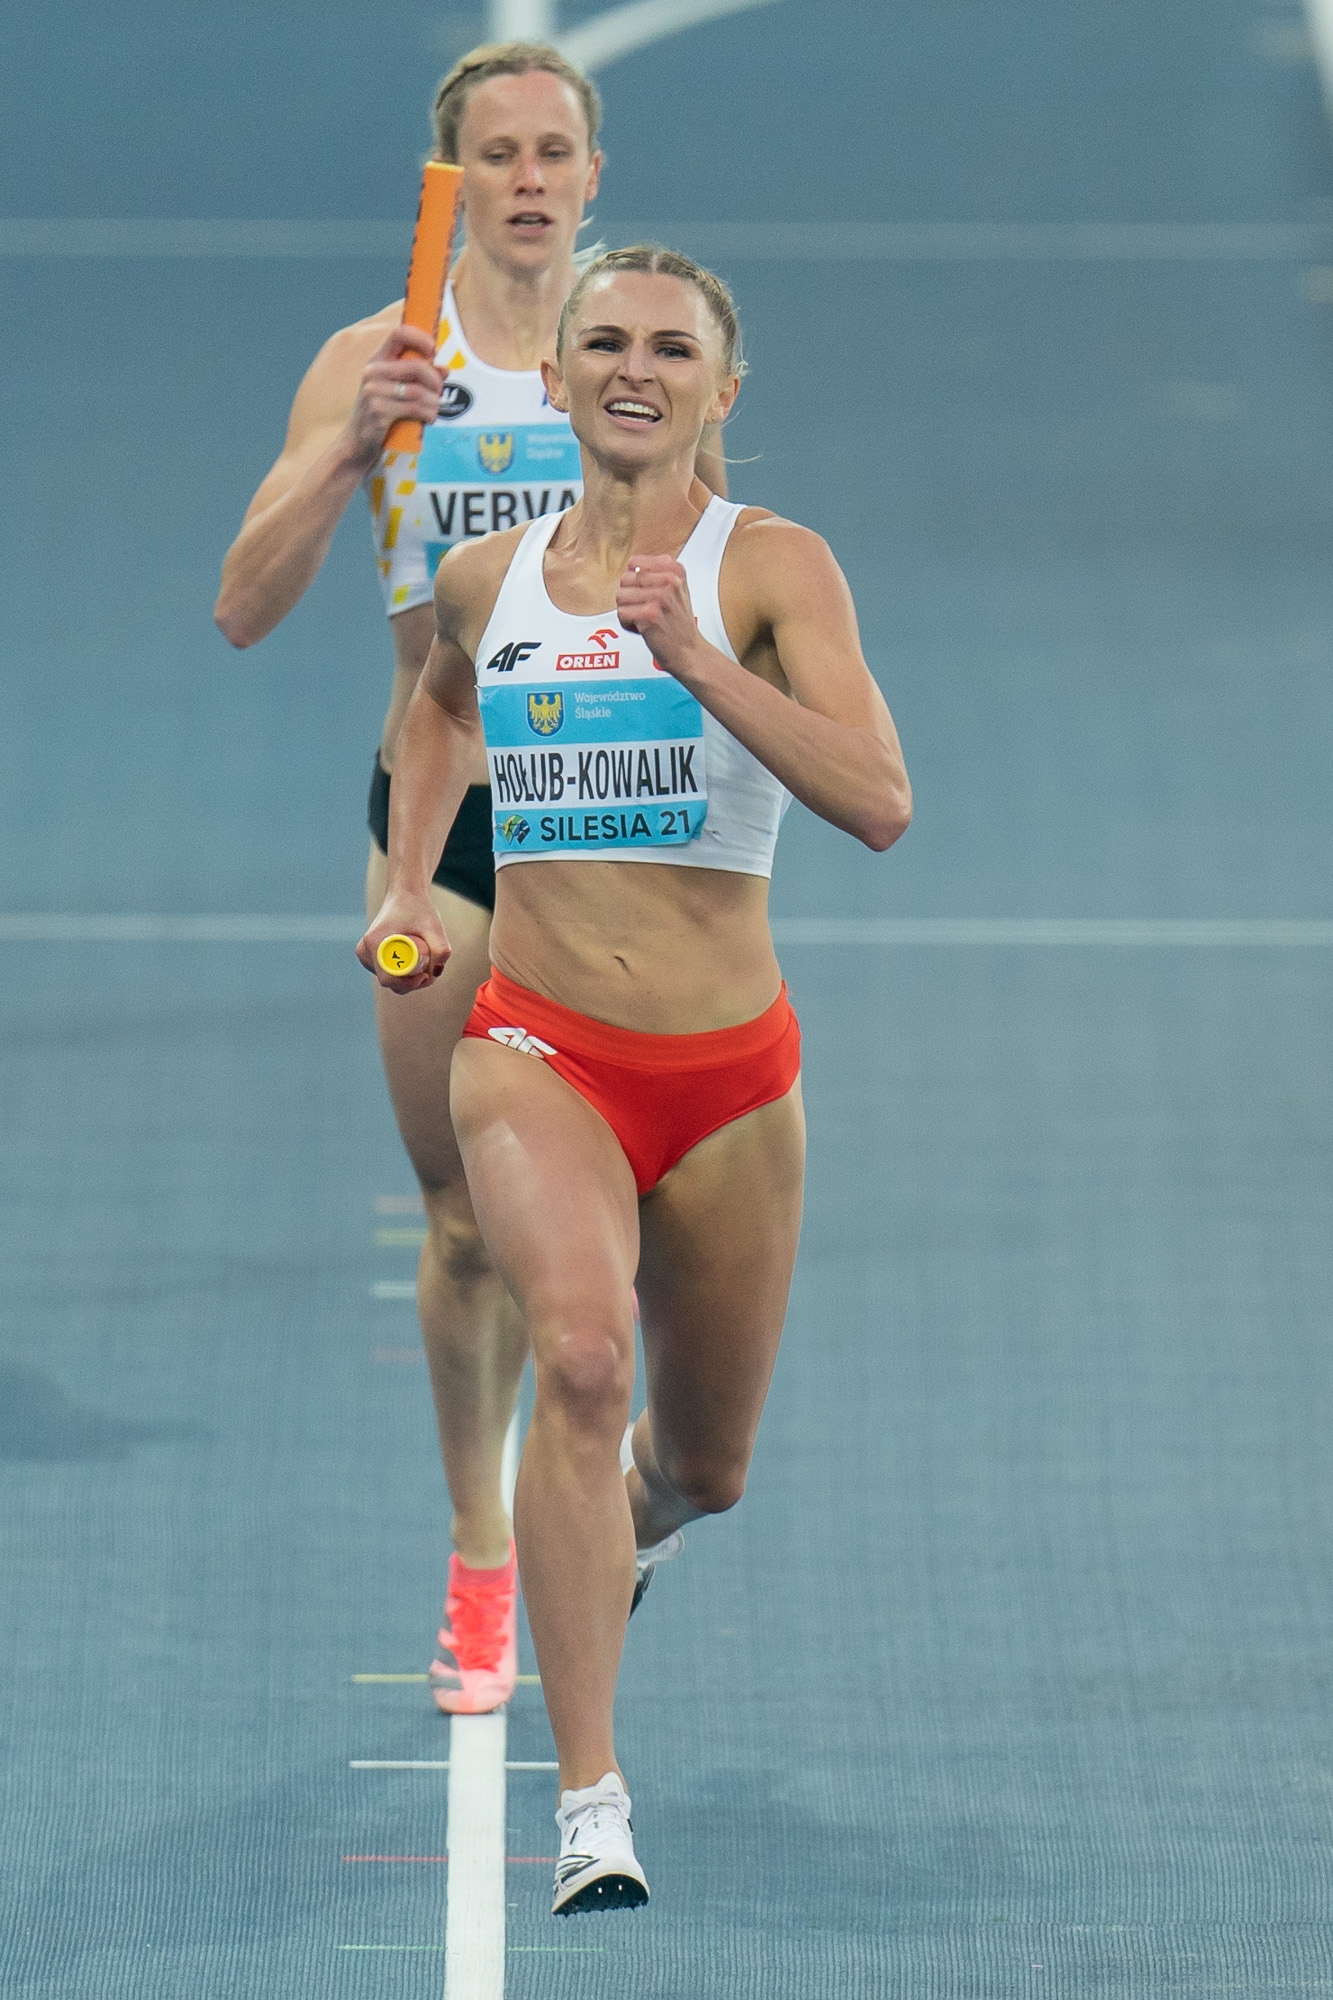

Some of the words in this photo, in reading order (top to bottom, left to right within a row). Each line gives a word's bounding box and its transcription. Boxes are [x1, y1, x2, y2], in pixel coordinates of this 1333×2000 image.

[486, 642, 542, 672] 4F
[558, 653, 617, 669] ORLEN
[573, 690, 646, 704] Województwo
[574, 706, 612, 720] Śląskie
[493, 745, 698, 803] HOŁUB-KOWALIK
[540, 812, 652, 842] SILESIA
[660, 809, 691, 836] 21
